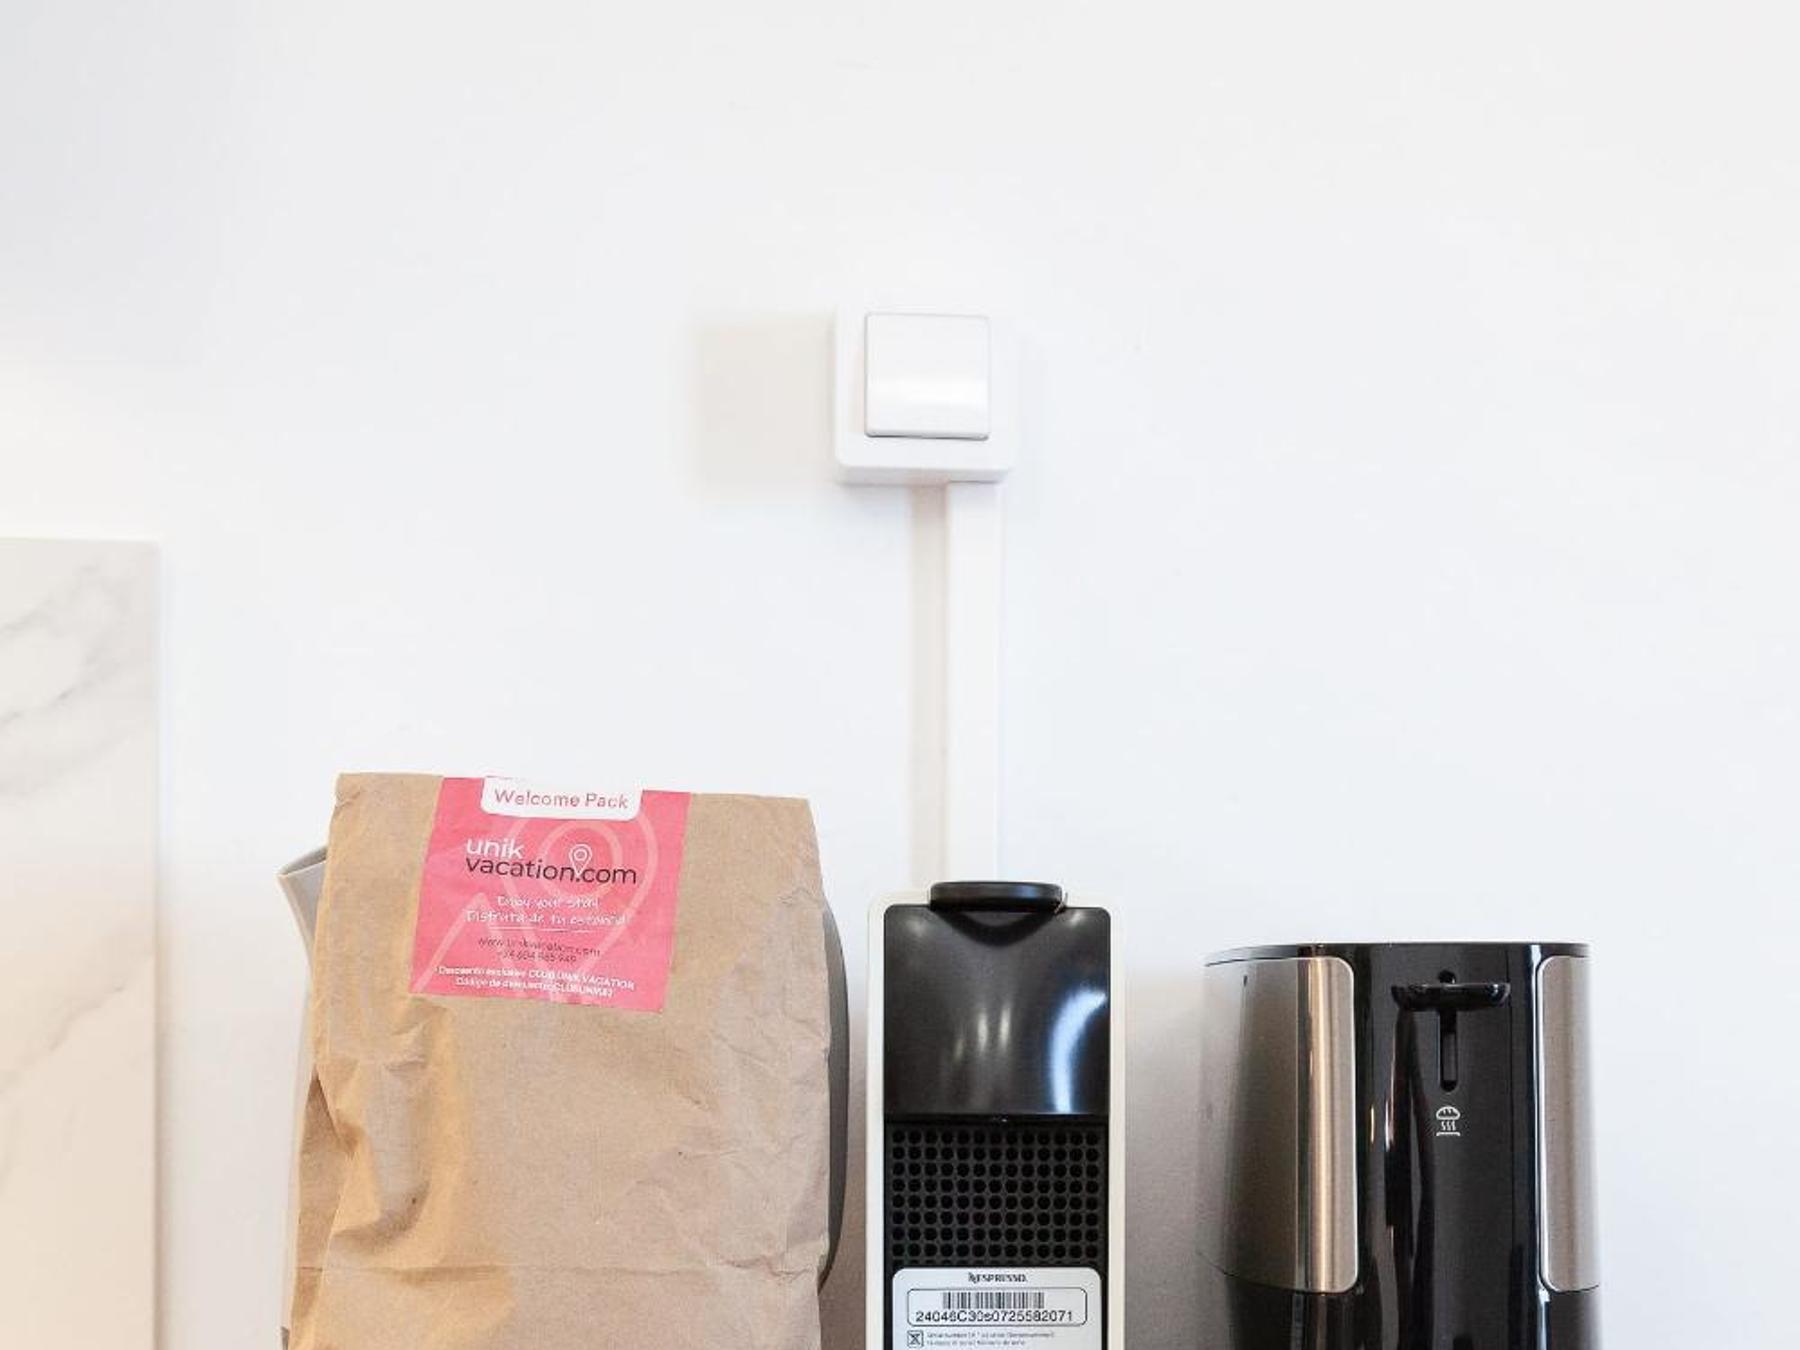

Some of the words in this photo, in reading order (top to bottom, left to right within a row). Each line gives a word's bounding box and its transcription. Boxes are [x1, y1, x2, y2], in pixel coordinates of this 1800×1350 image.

[494, 788, 580, 807] Welcome
[584, 792, 629, 809] Pack
[466, 838, 524, 860] unik
[466, 856, 637, 884] vacation.com
